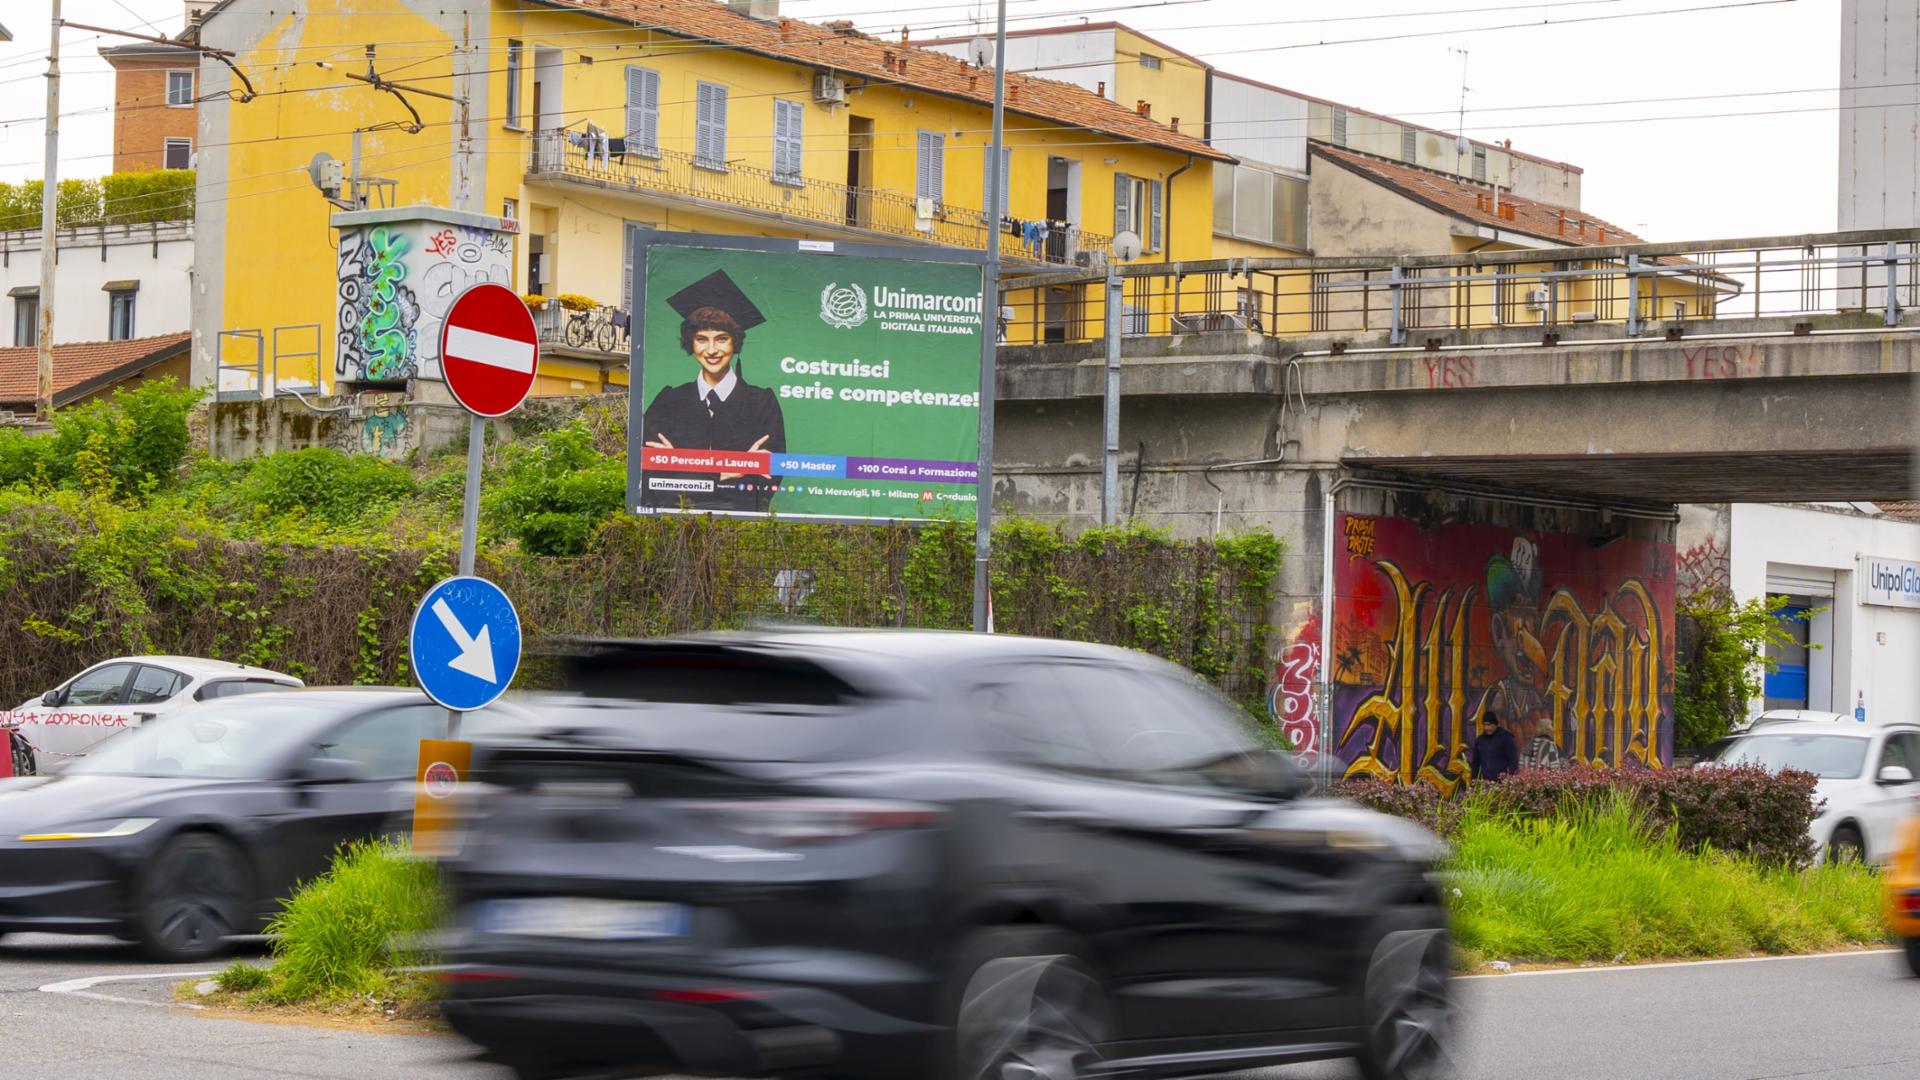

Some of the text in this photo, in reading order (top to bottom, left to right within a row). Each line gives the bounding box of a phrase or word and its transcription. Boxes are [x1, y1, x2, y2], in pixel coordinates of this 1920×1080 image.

[874, 286, 982, 313] Unimarconi
[874, 310, 981, 324] LA PRIMA UNIVERSITÀ
[881, 321, 974, 335] DIGITALE ITALIANA
[780, 356, 890, 378] Costruisci
[1423, 355, 1476, 387] YES
[779, 381, 980, 407] serie competenze!
[650, 454, 667, 465] +50
[670, 455, 714, 466] Percorsi
[725, 458, 760, 468] Laurea
[780, 460, 837, 471] +50 Master
[857, 464, 879, 474] +100
[882, 465, 908, 475] Corsi
[918, 467, 978, 478] Formazione
[651, 479, 711, 491] unimarconi.it
[807, 486, 823, 496] Via
[825, 487, 870, 499] Meravigli,
[888, 490, 919, 499] Milano
